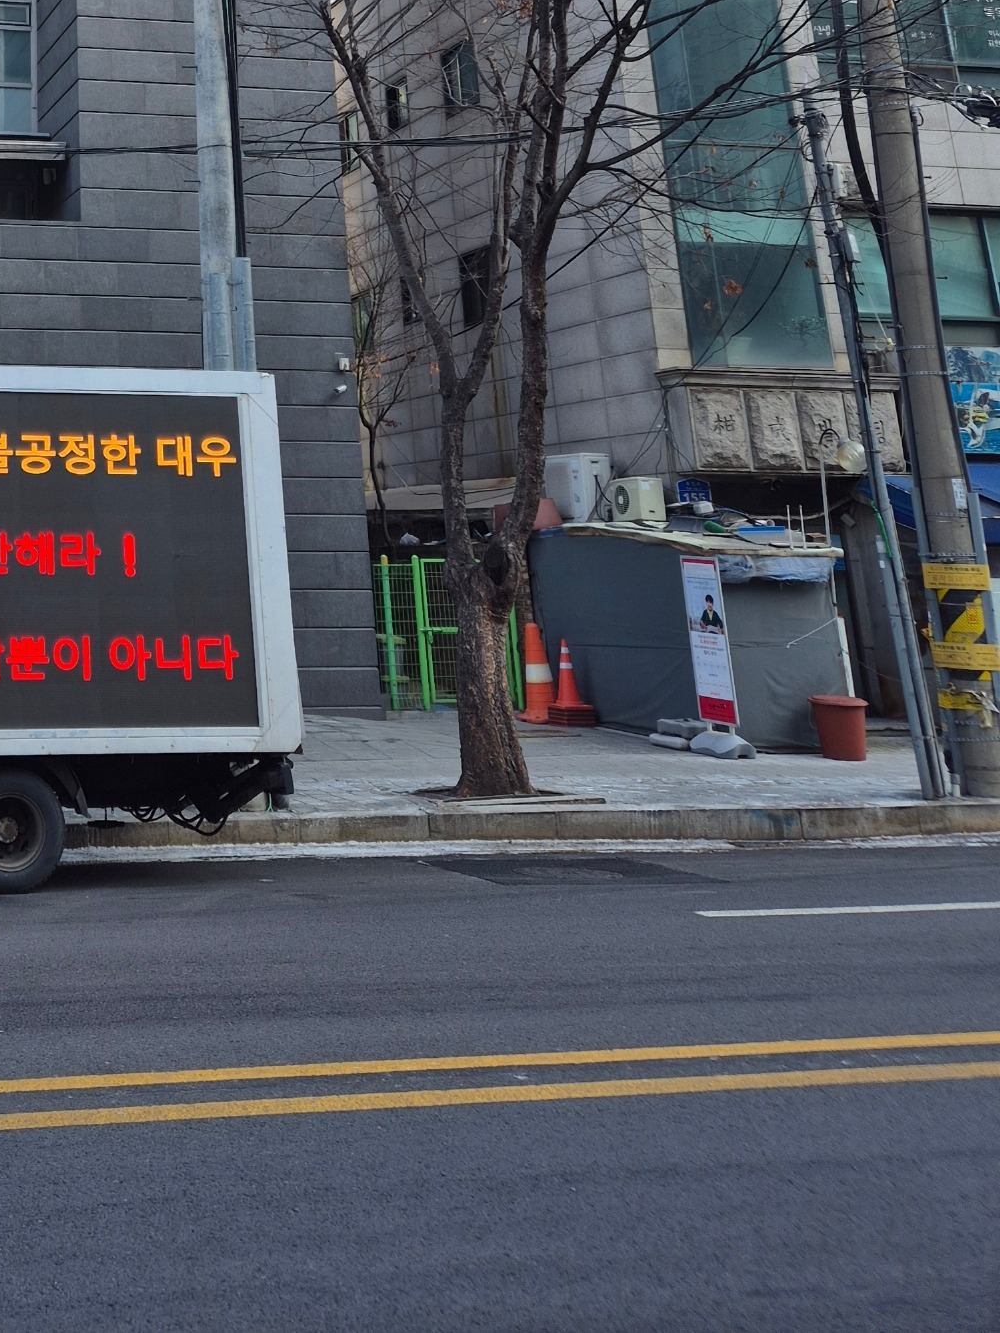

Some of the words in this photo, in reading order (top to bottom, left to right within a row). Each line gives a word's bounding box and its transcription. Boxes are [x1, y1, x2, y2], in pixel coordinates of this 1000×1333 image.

[156, 435, 237, 477] 대우
[122, 533, 137, 578] !
[108, 634, 240, 682] 아니다
